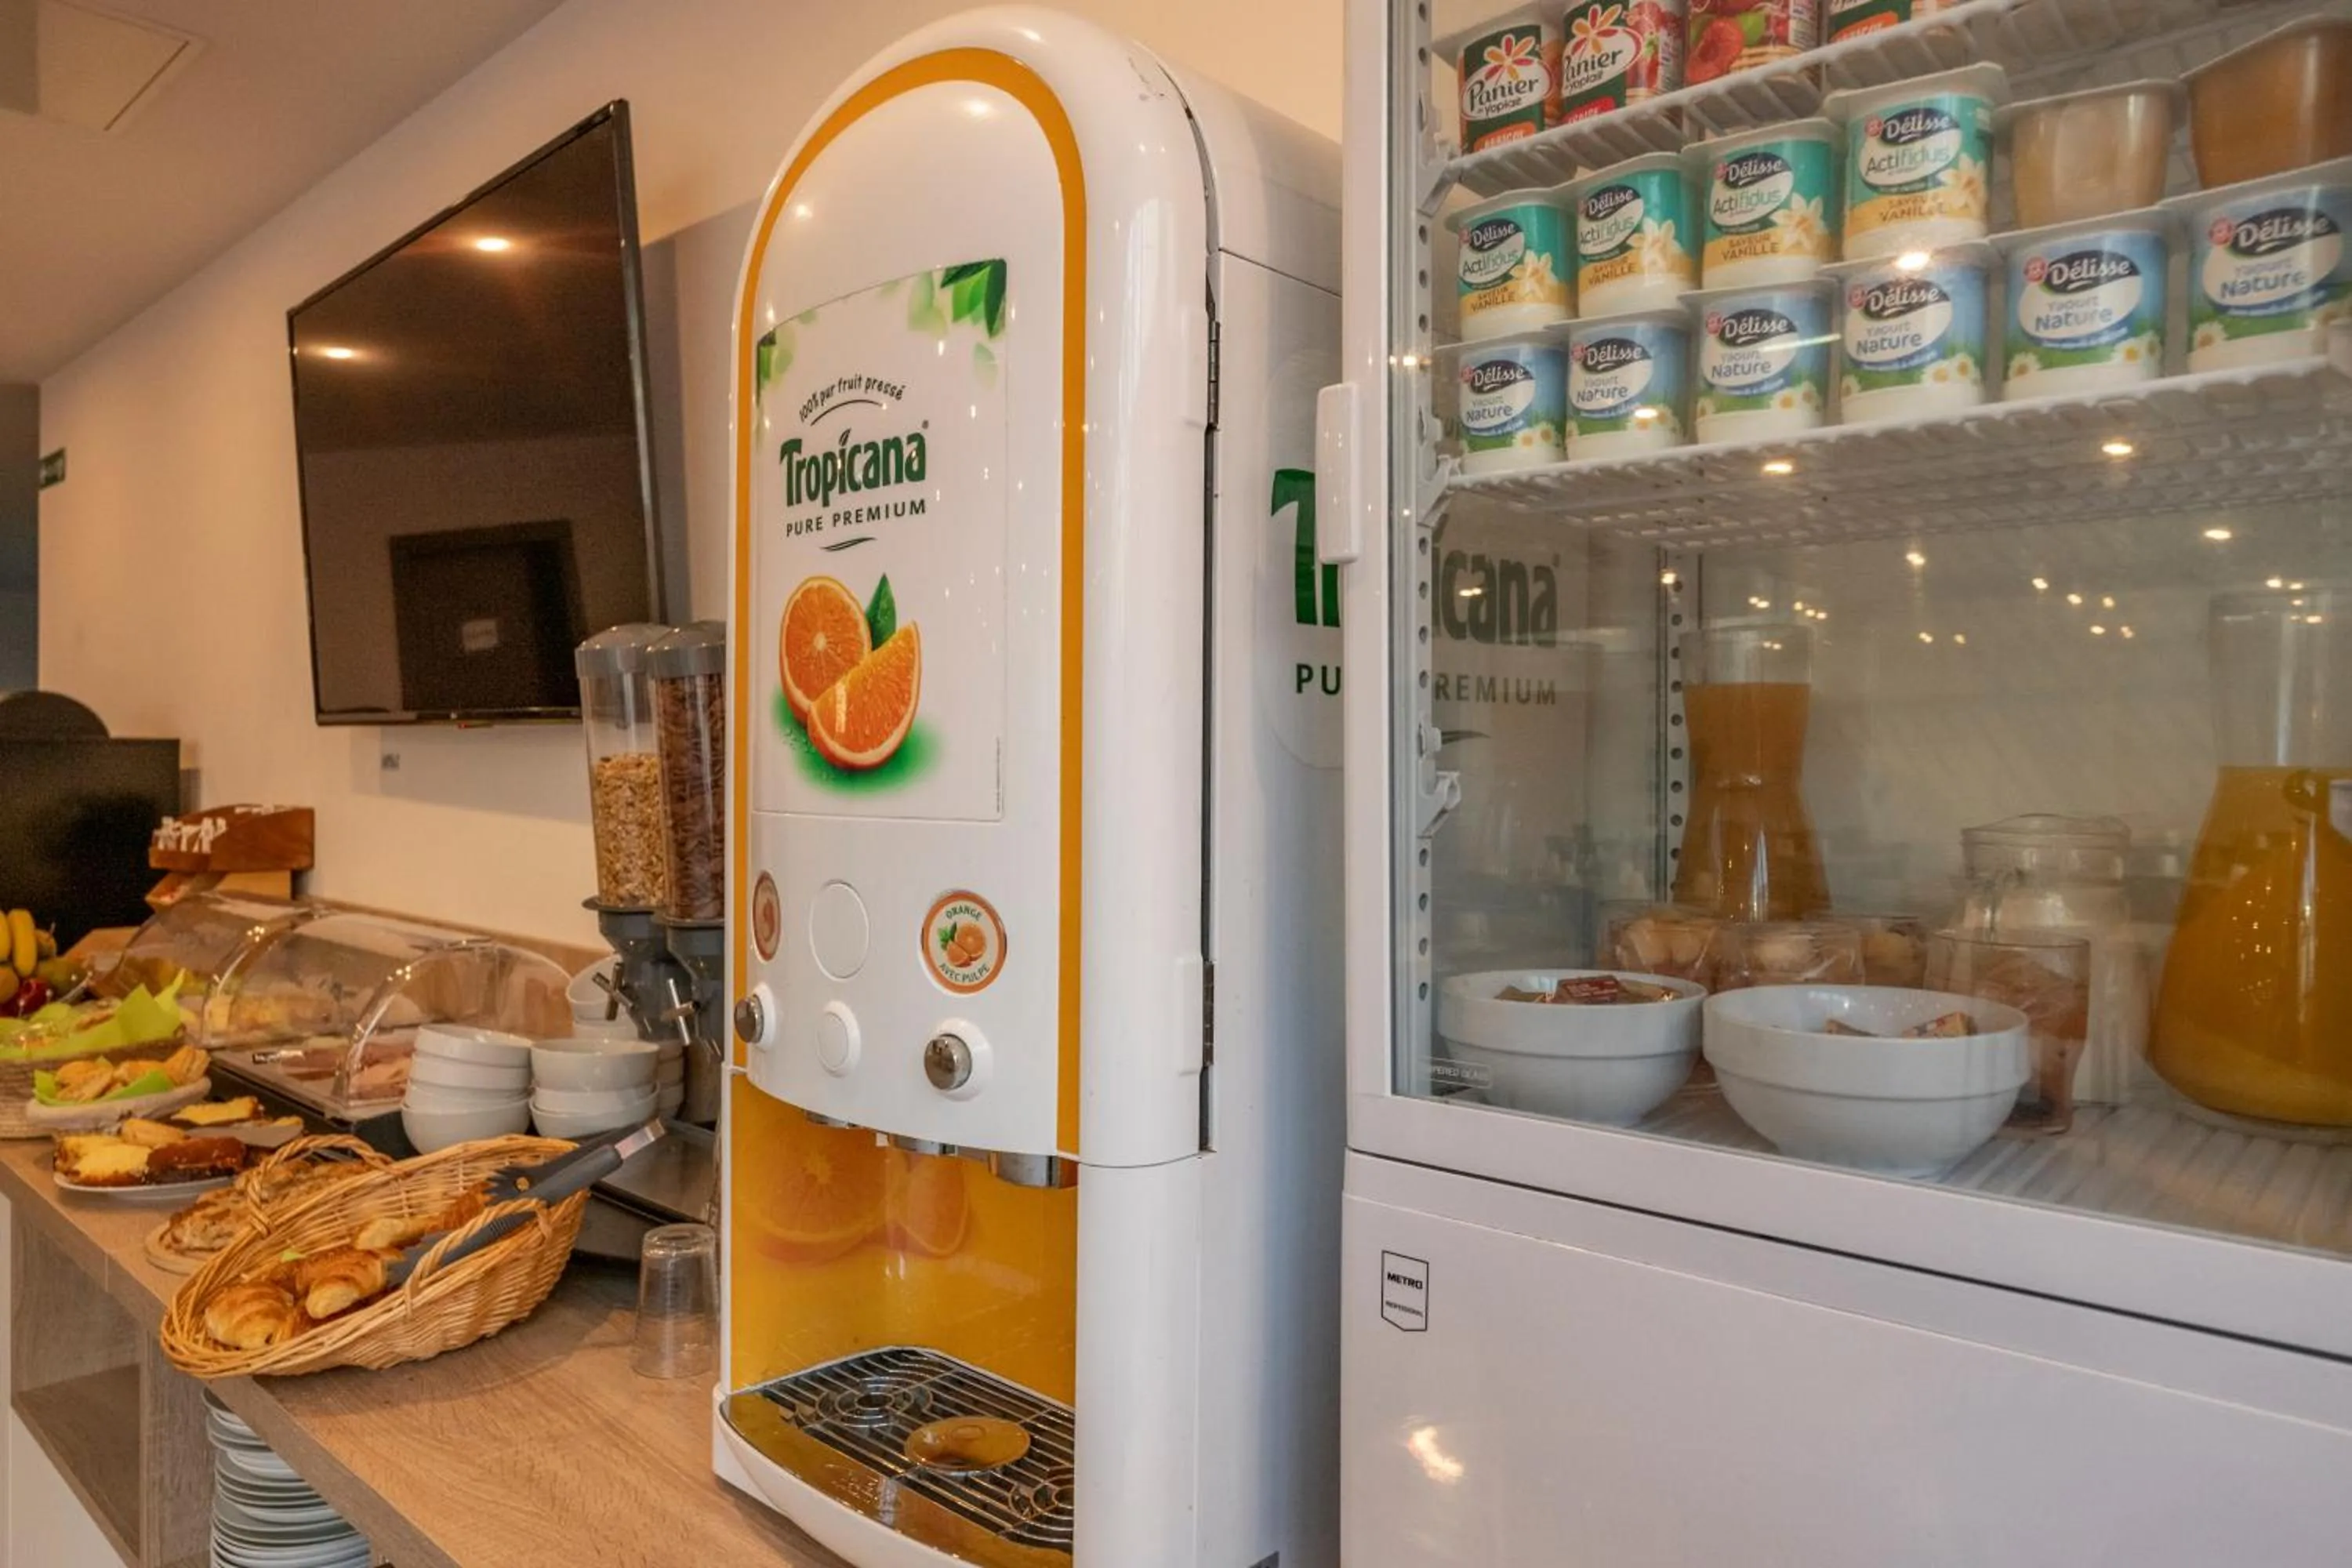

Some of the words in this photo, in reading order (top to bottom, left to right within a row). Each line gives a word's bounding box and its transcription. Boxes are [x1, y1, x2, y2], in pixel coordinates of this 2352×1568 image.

[1468, 78, 1539, 113] Panier
[1886, 115, 1950, 139] Délisse
[1727, 159, 1783, 182] Délisse
[1588, 188, 1634, 215] Délisse
[1472, 223, 1516, 246] Délisse
[2237, 217, 2331, 247] Délisse
[1720, 241, 1781, 262] VANILLE
[1588, 263, 1636, 286] VANILLE
[2050, 258, 2132, 285] Délisse
[2220, 272, 2305, 299] Nature
[1470, 291, 1516, 312] VANILLE
[1869, 288, 1940, 312] Délisse
[1725, 316, 1789, 338] Délisse
[2034, 308, 2114, 332] Nature
[1587, 344, 1642, 365] Délisse
[1856, 333, 1923, 355] Nature
[1474, 365, 1524, 387] Délisse
[1711, 361, 1771, 379] Nature
[800, 390, 818, 423] 100%
[819, 384, 837, 404] pur
[838, 373, 863, 394] fruit
[865, 376, 907, 401] pressé
[1576, 386, 1628, 403] Nature
[1466, 405, 1513, 423] Nature
[780, 428, 927, 508] Tropicana
[786, 516, 824, 538] PURE
[832, 498, 927, 528] PREMIUM
[1433, 672, 1556, 706] REMIUM
[945, 904, 982, 921] ORANGE
[1386, 1271, 1424, 1290] METRO
